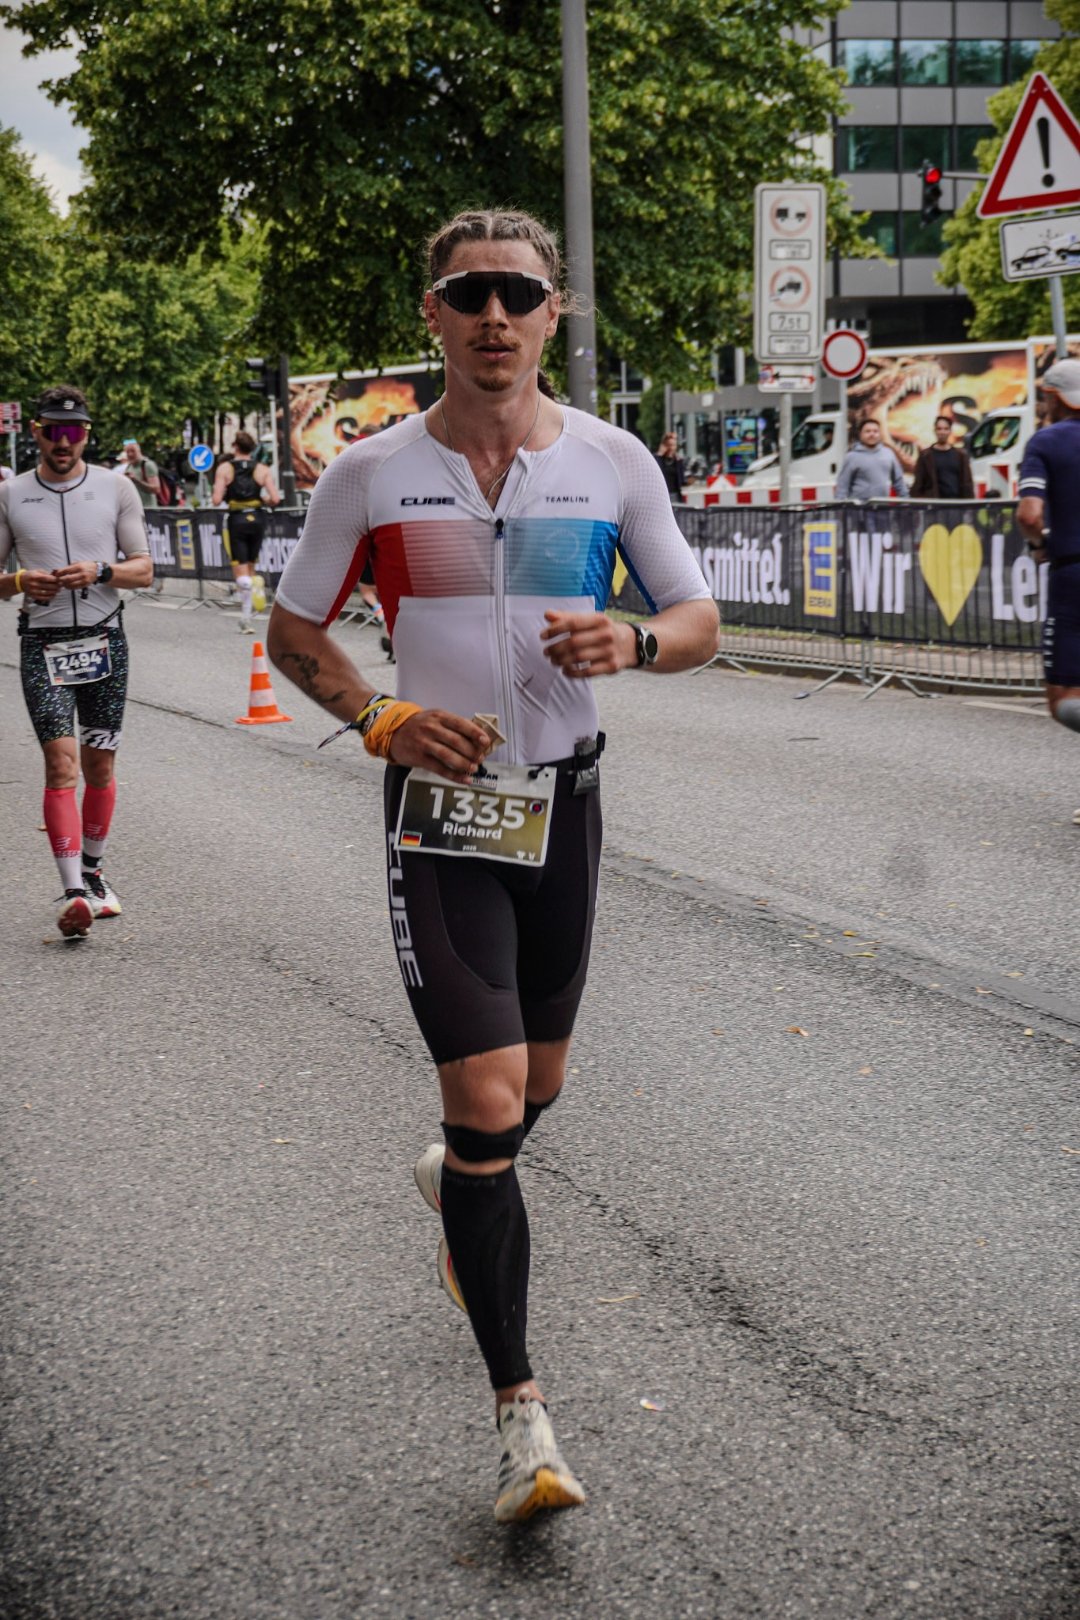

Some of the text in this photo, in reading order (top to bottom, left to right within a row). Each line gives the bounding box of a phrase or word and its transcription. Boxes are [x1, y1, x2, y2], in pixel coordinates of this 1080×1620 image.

[400, 496, 455, 506] CUBE
[848, 532, 912, 614] Wir
[57, 651, 103, 670] 2494
[429, 787, 526, 830] 1335
[442, 821, 503, 841] Richard
